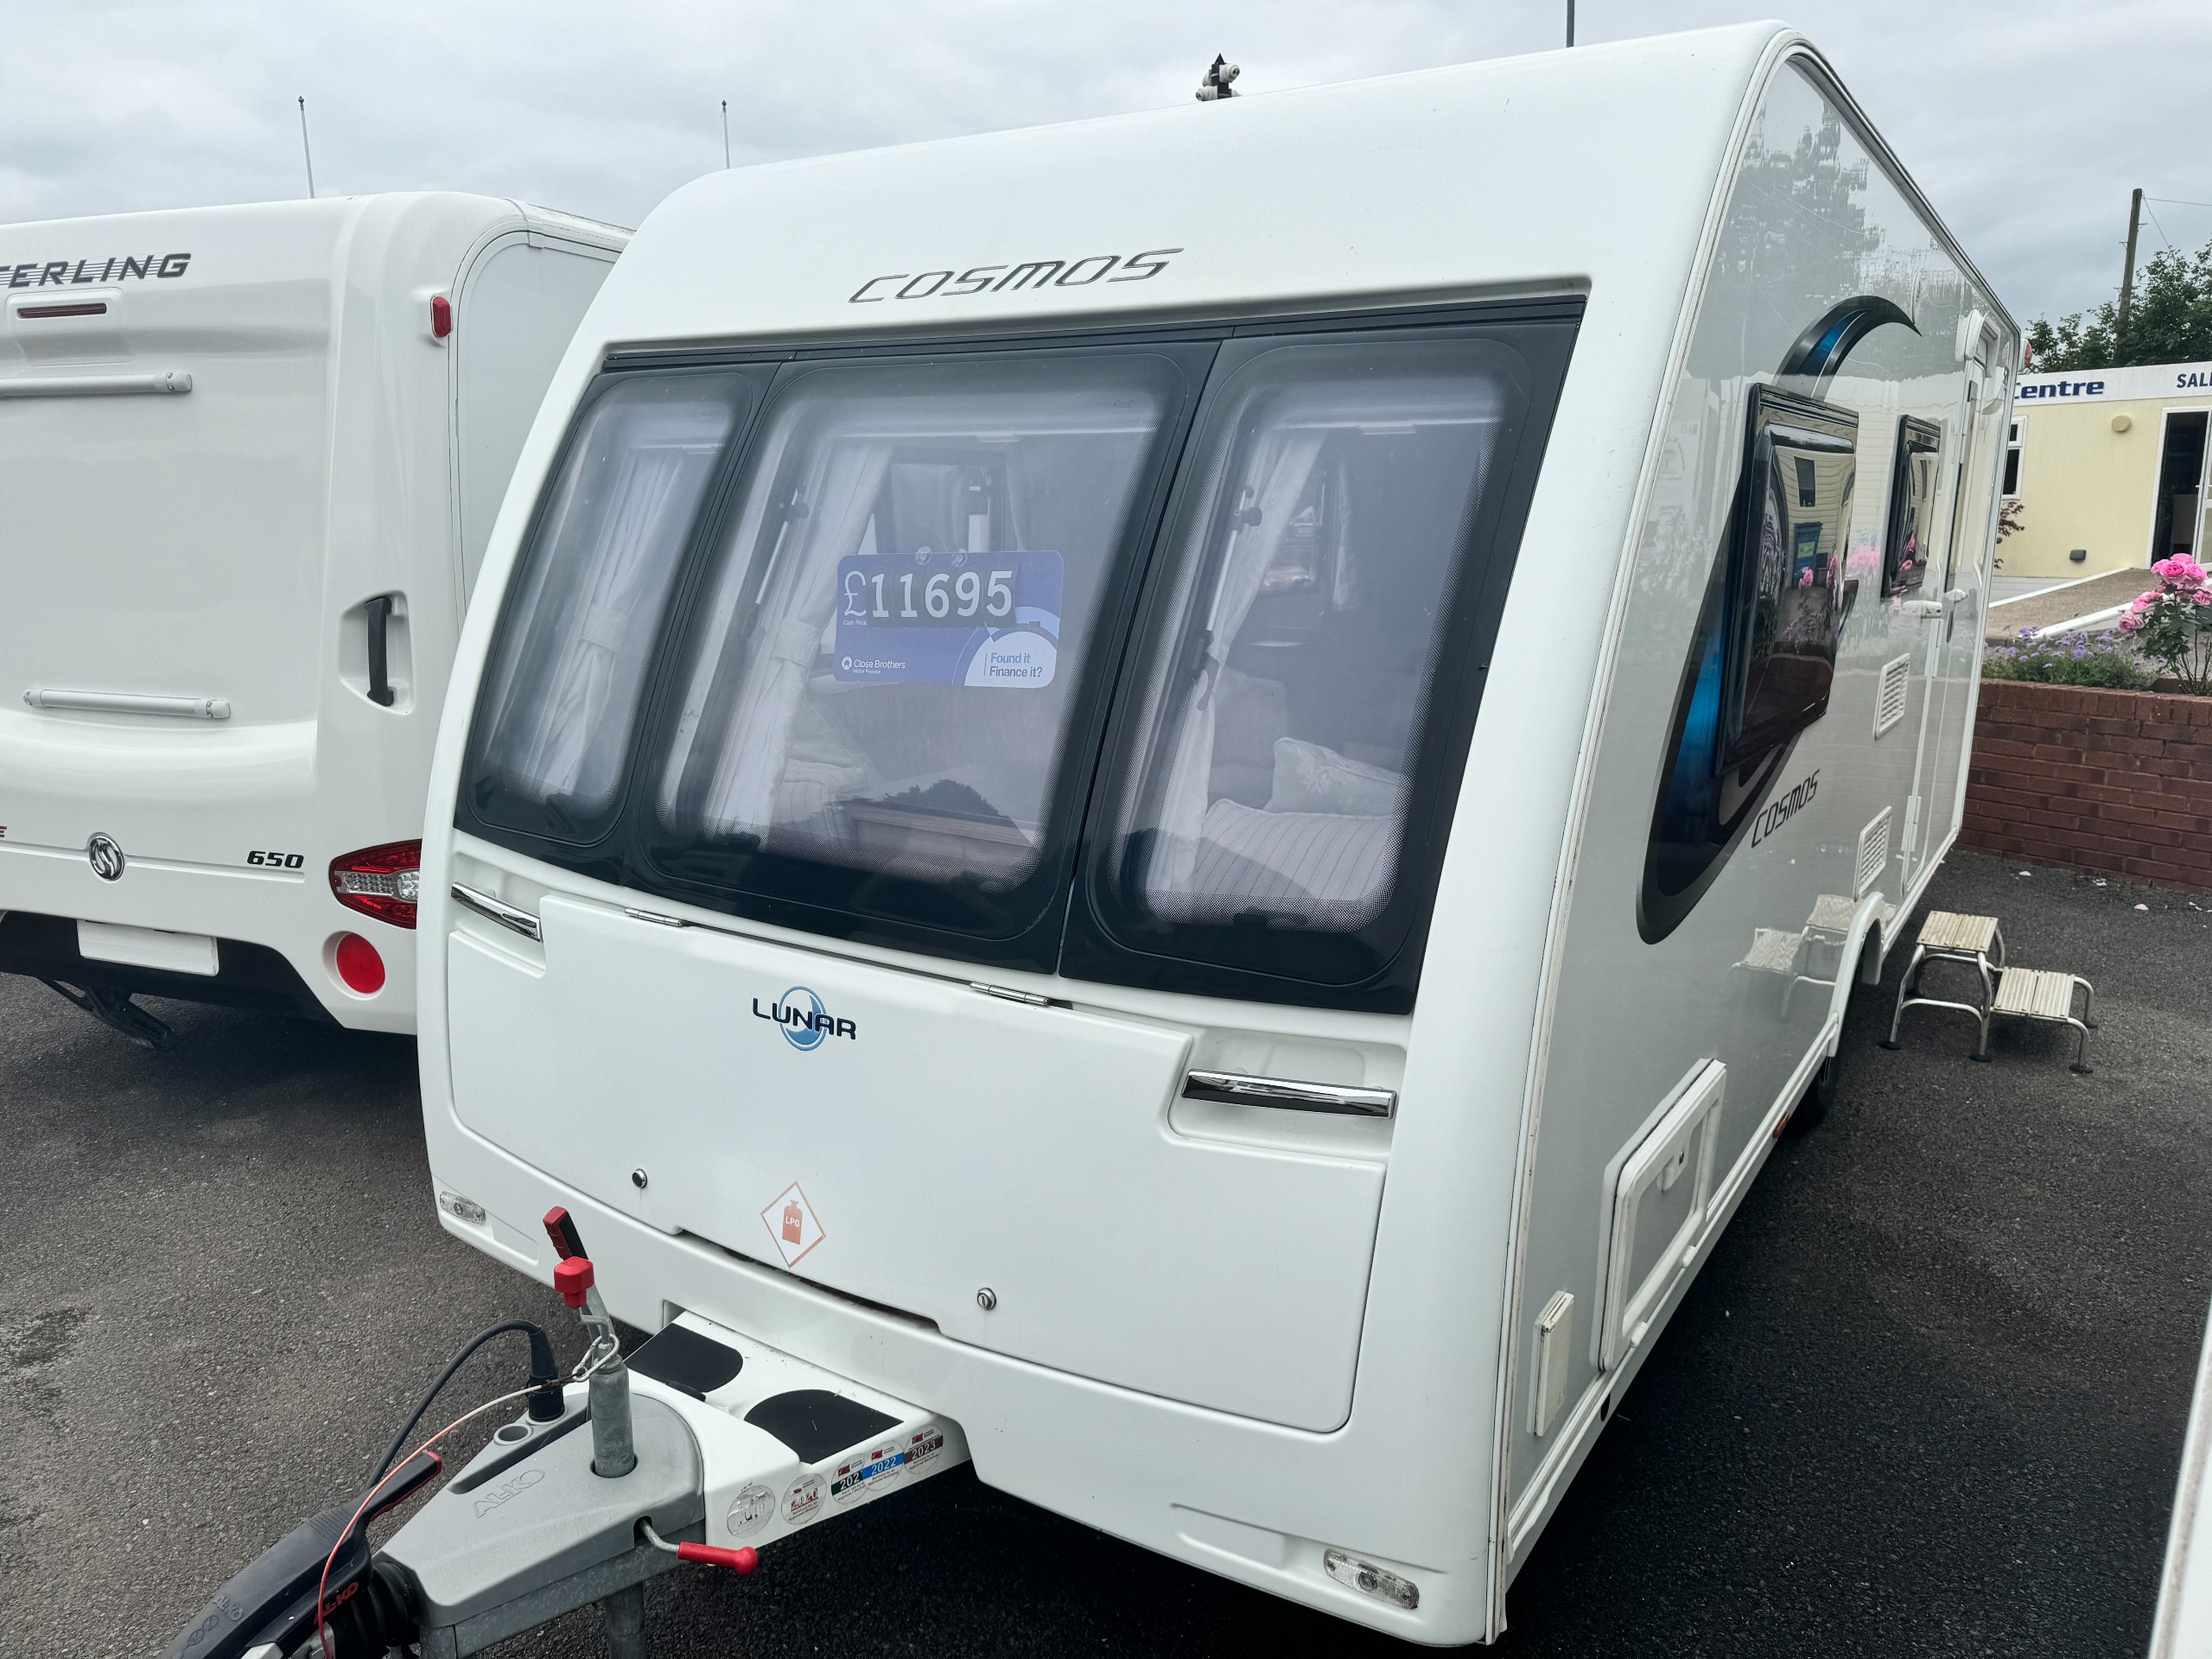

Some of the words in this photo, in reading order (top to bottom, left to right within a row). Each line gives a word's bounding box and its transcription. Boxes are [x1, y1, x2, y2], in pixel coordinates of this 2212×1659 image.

[848, 247, 1185, 303] COSMOS
[2176, 372, 2212, 389] SAL
[844, 570, 1013, 619] £11695
[853, 659, 874, 668] Close
[874, 660, 906, 669] Brothers
[990, 652, 1022, 664] Found
[1023, 652, 1031, 664] it
[989, 665, 1028, 677] Finance
[1029, 666, 1043, 677] it?
[1751, 768, 1821, 849] COSMOS
[246, 850, 304, 868] 650
[752, 997, 856, 1040] LUNAR
[785, 1216, 800, 1228] LPG
[912, 1440, 936, 1460] 2023
[871, 1456, 897, 1476] 2022
[839, 1471, 863, 1491] 202
